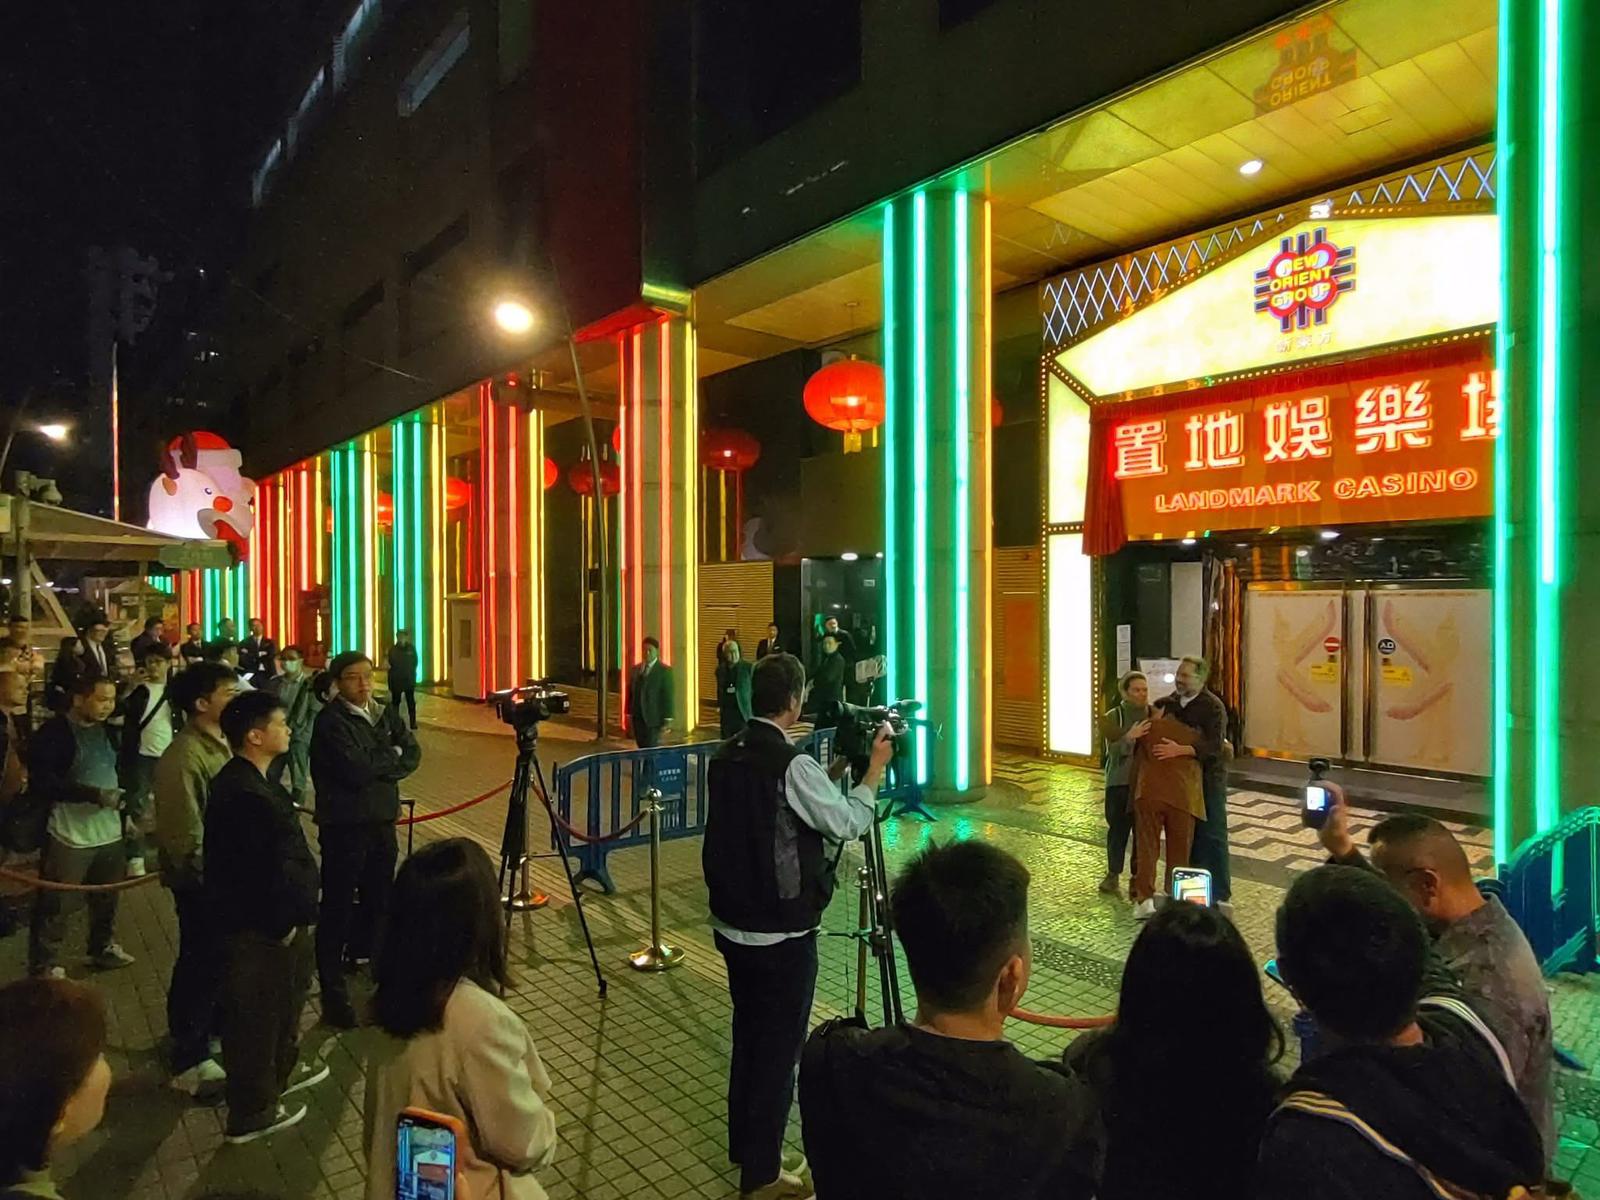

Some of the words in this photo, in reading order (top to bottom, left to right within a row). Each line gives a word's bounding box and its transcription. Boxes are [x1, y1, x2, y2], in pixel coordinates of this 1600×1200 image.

[1282, 254, 1319, 274] NEW
[1270, 265, 1333, 291] ORIENT
[1270, 282, 1331, 307] GROUP
[1155, 481, 1321, 513] LANDMARK
[1334, 467, 1478, 499] CASINO
